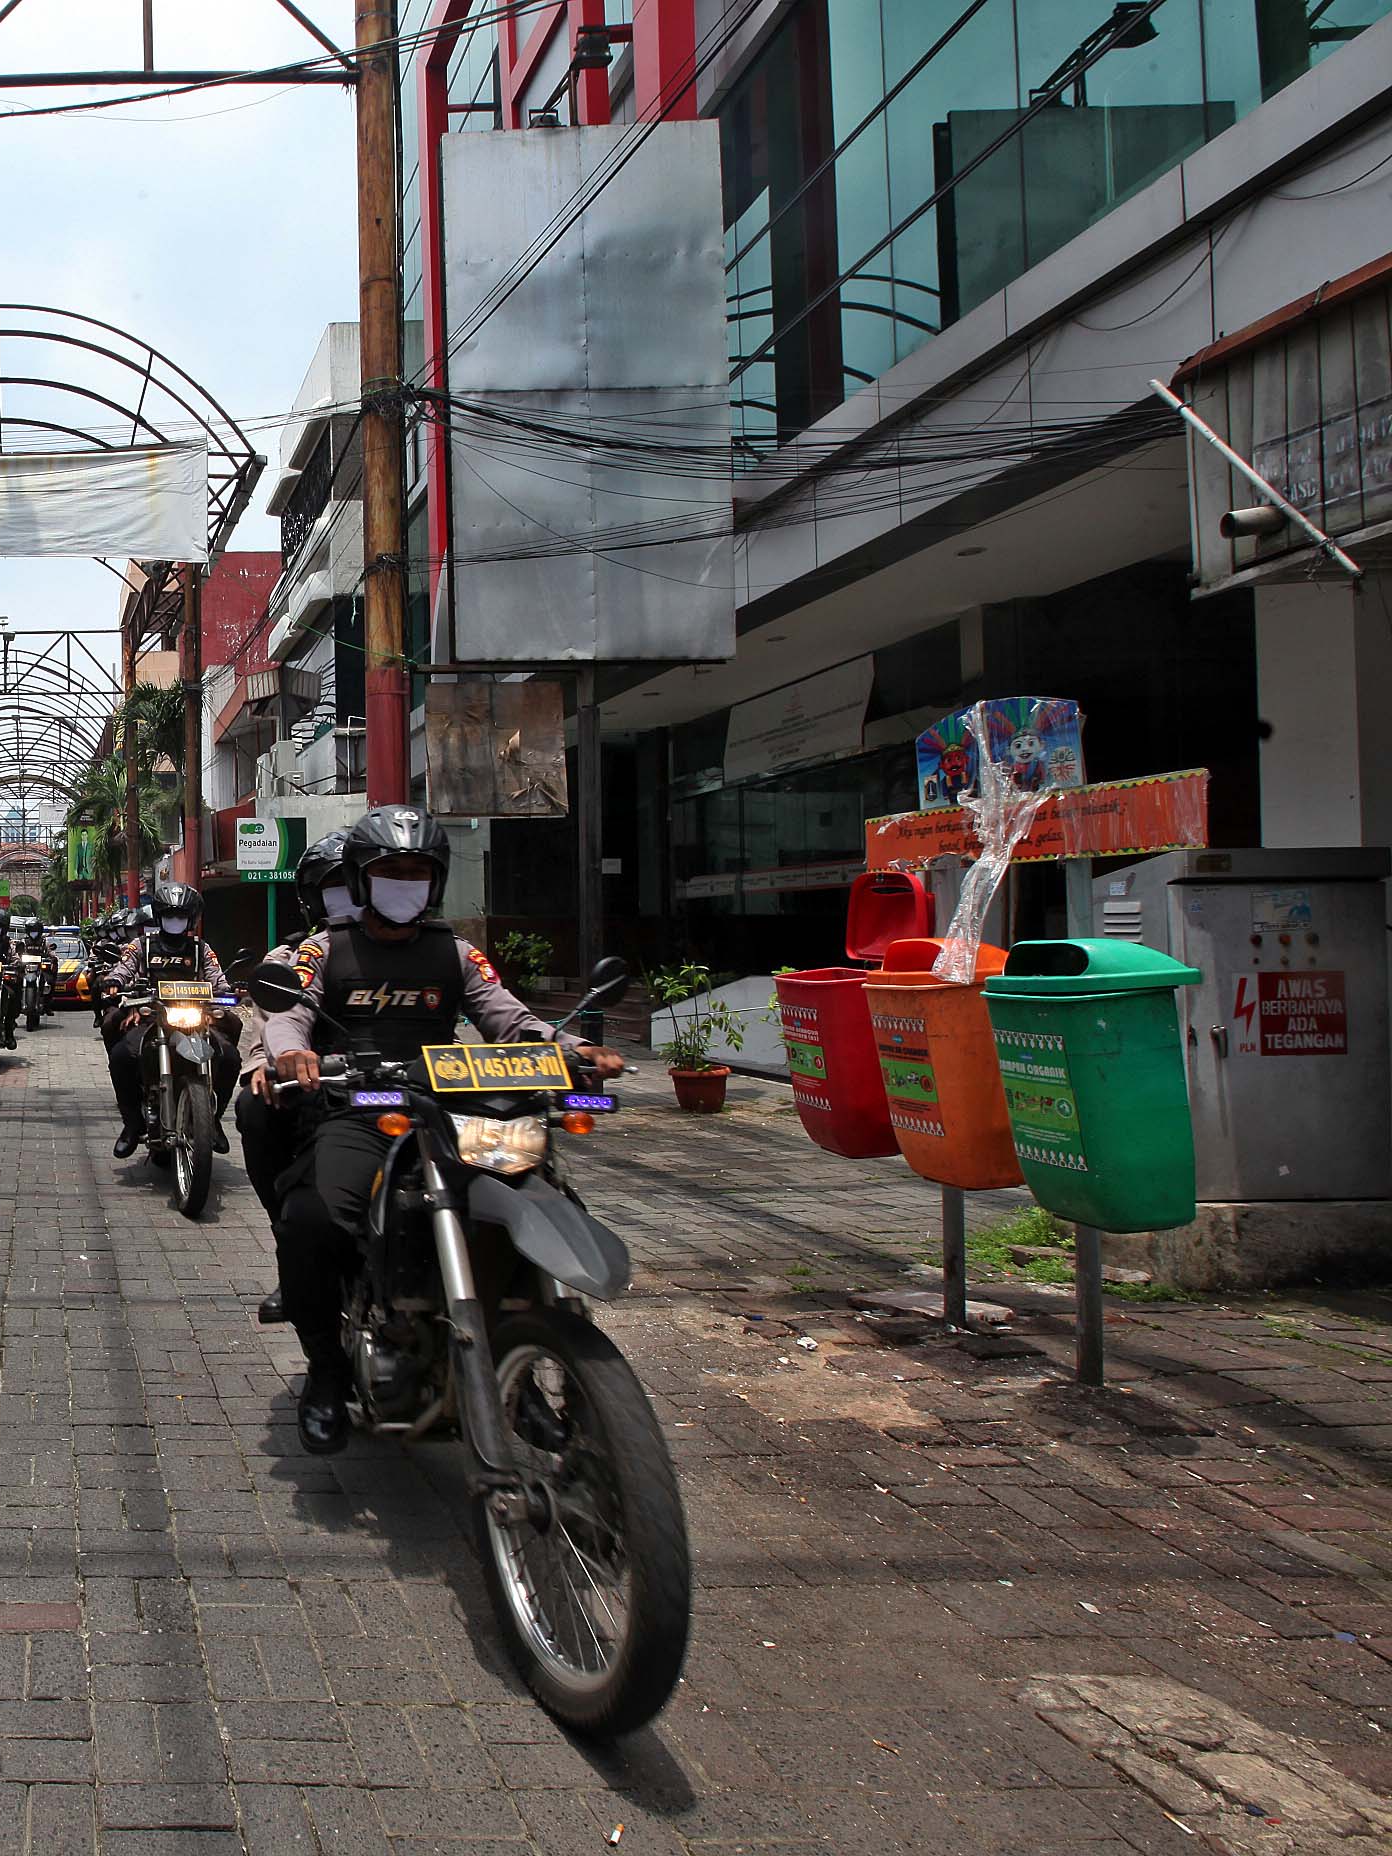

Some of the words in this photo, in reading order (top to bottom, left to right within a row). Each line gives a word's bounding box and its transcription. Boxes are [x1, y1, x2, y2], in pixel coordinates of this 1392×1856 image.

[239, 839, 277, 848] Pegadaian
[248, 872, 261, 880] 021
[1277, 977, 1328, 998] AWAS
[1262, 999, 1344, 1016] BERBAHAYA
[1288, 1017, 1318, 1032] ADA
[1240, 1042, 1256, 1053] PLN
[1264, 1033, 1344, 1049] TEGANGAN
[474, 1055, 562, 1078] 145123-VII
